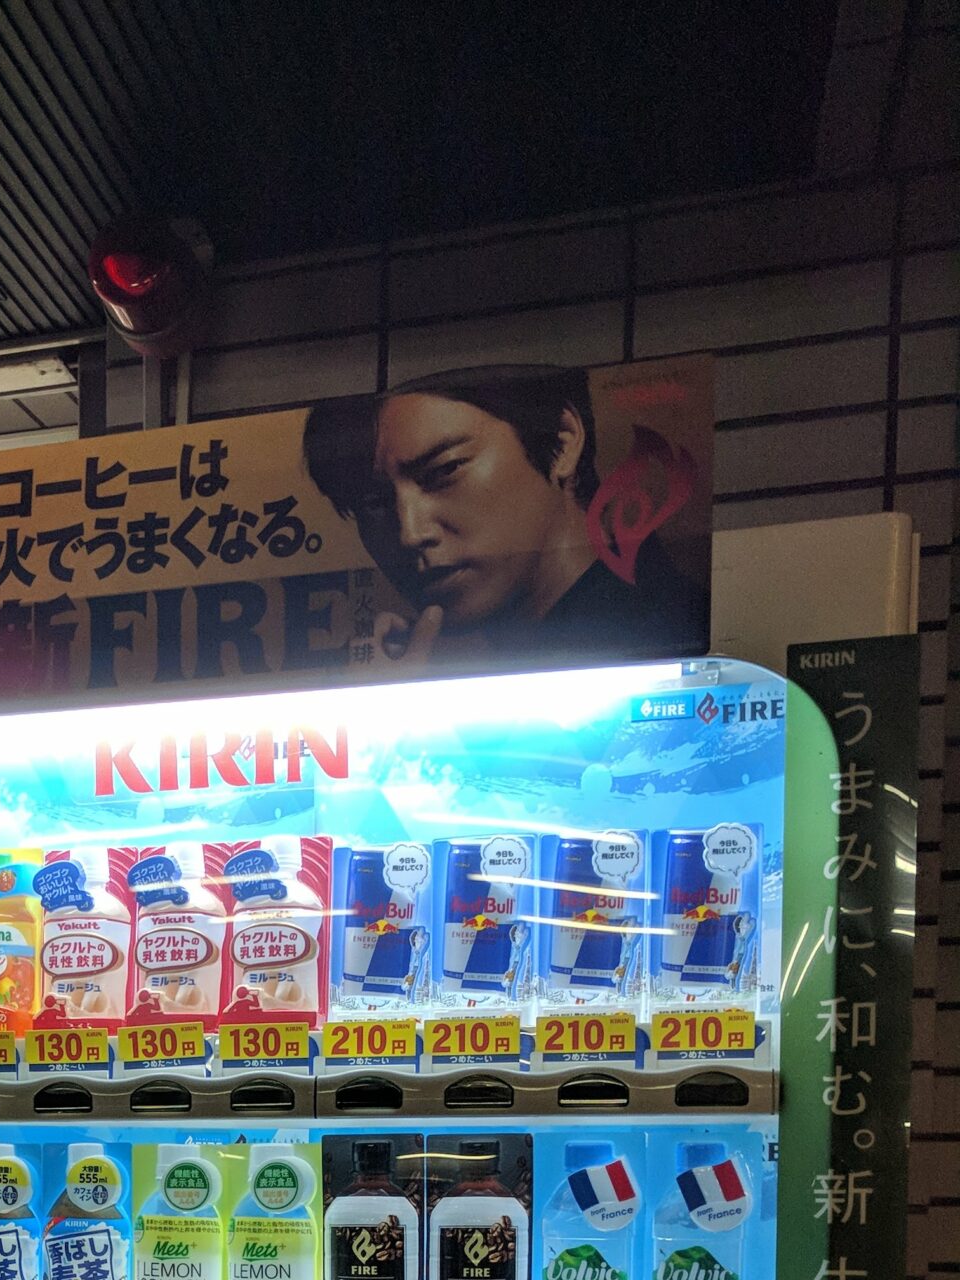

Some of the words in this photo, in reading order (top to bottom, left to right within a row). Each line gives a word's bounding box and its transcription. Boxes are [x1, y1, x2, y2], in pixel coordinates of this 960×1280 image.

[800, 650, 856, 669] KIRIN
[653, 704, 686, 716] FIRE
[723, 699, 784, 724] FIRE
[95, 726, 349, 796] KIRIN
[594, 893, 624, 909] Bull
[671, 887, 705, 904] Red
[705, 887, 738, 905] Bull
[386, 902, 414, 919] Bull
[451, 896, 483, 912] Red
[484, 898, 514, 914] Bull
[57, 922, 101, 931] Yakult
[143, 935, 199, 949] ヤクルトの
[240, 931, 298, 945] ヤクルトの
[49, 941, 105, 955] ヤクルトの
[240, 946, 297, 959] 乳性飲料
[48, 955, 105, 969] 乳性飲料
[142, 949, 199, 963] 乳性飲料
[151, 976, 195, 987] ミルージュ
[249, 973, 295, 983] ミルージュ
[57, 983, 101, 993] ミルージュ
[331, 1025, 407, 1055] 210円
[432, 1022, 510, 1053] 210円
[544, 1019, 625, 1051] 210円
[660, 1016, 744, 1049] 210円
[34, 1032, 100, 1062] 130円
[128, 1027, 196, 1059] 130円
[229, 1027, 300, 1057] 130円
[590, 1206, 606, 1217] from
[601, 1206, 635, 1221] France
[697, 1206, 713, 1217] from
[708, 1206, 743, 1221] France
[143, 1263, 202, 1277] LEMON
[234, 1264, 291, 1278] LEMON
[351, 1266, 378, 1275] FIRE
[463, 1268, 490, 1277] FIRE
